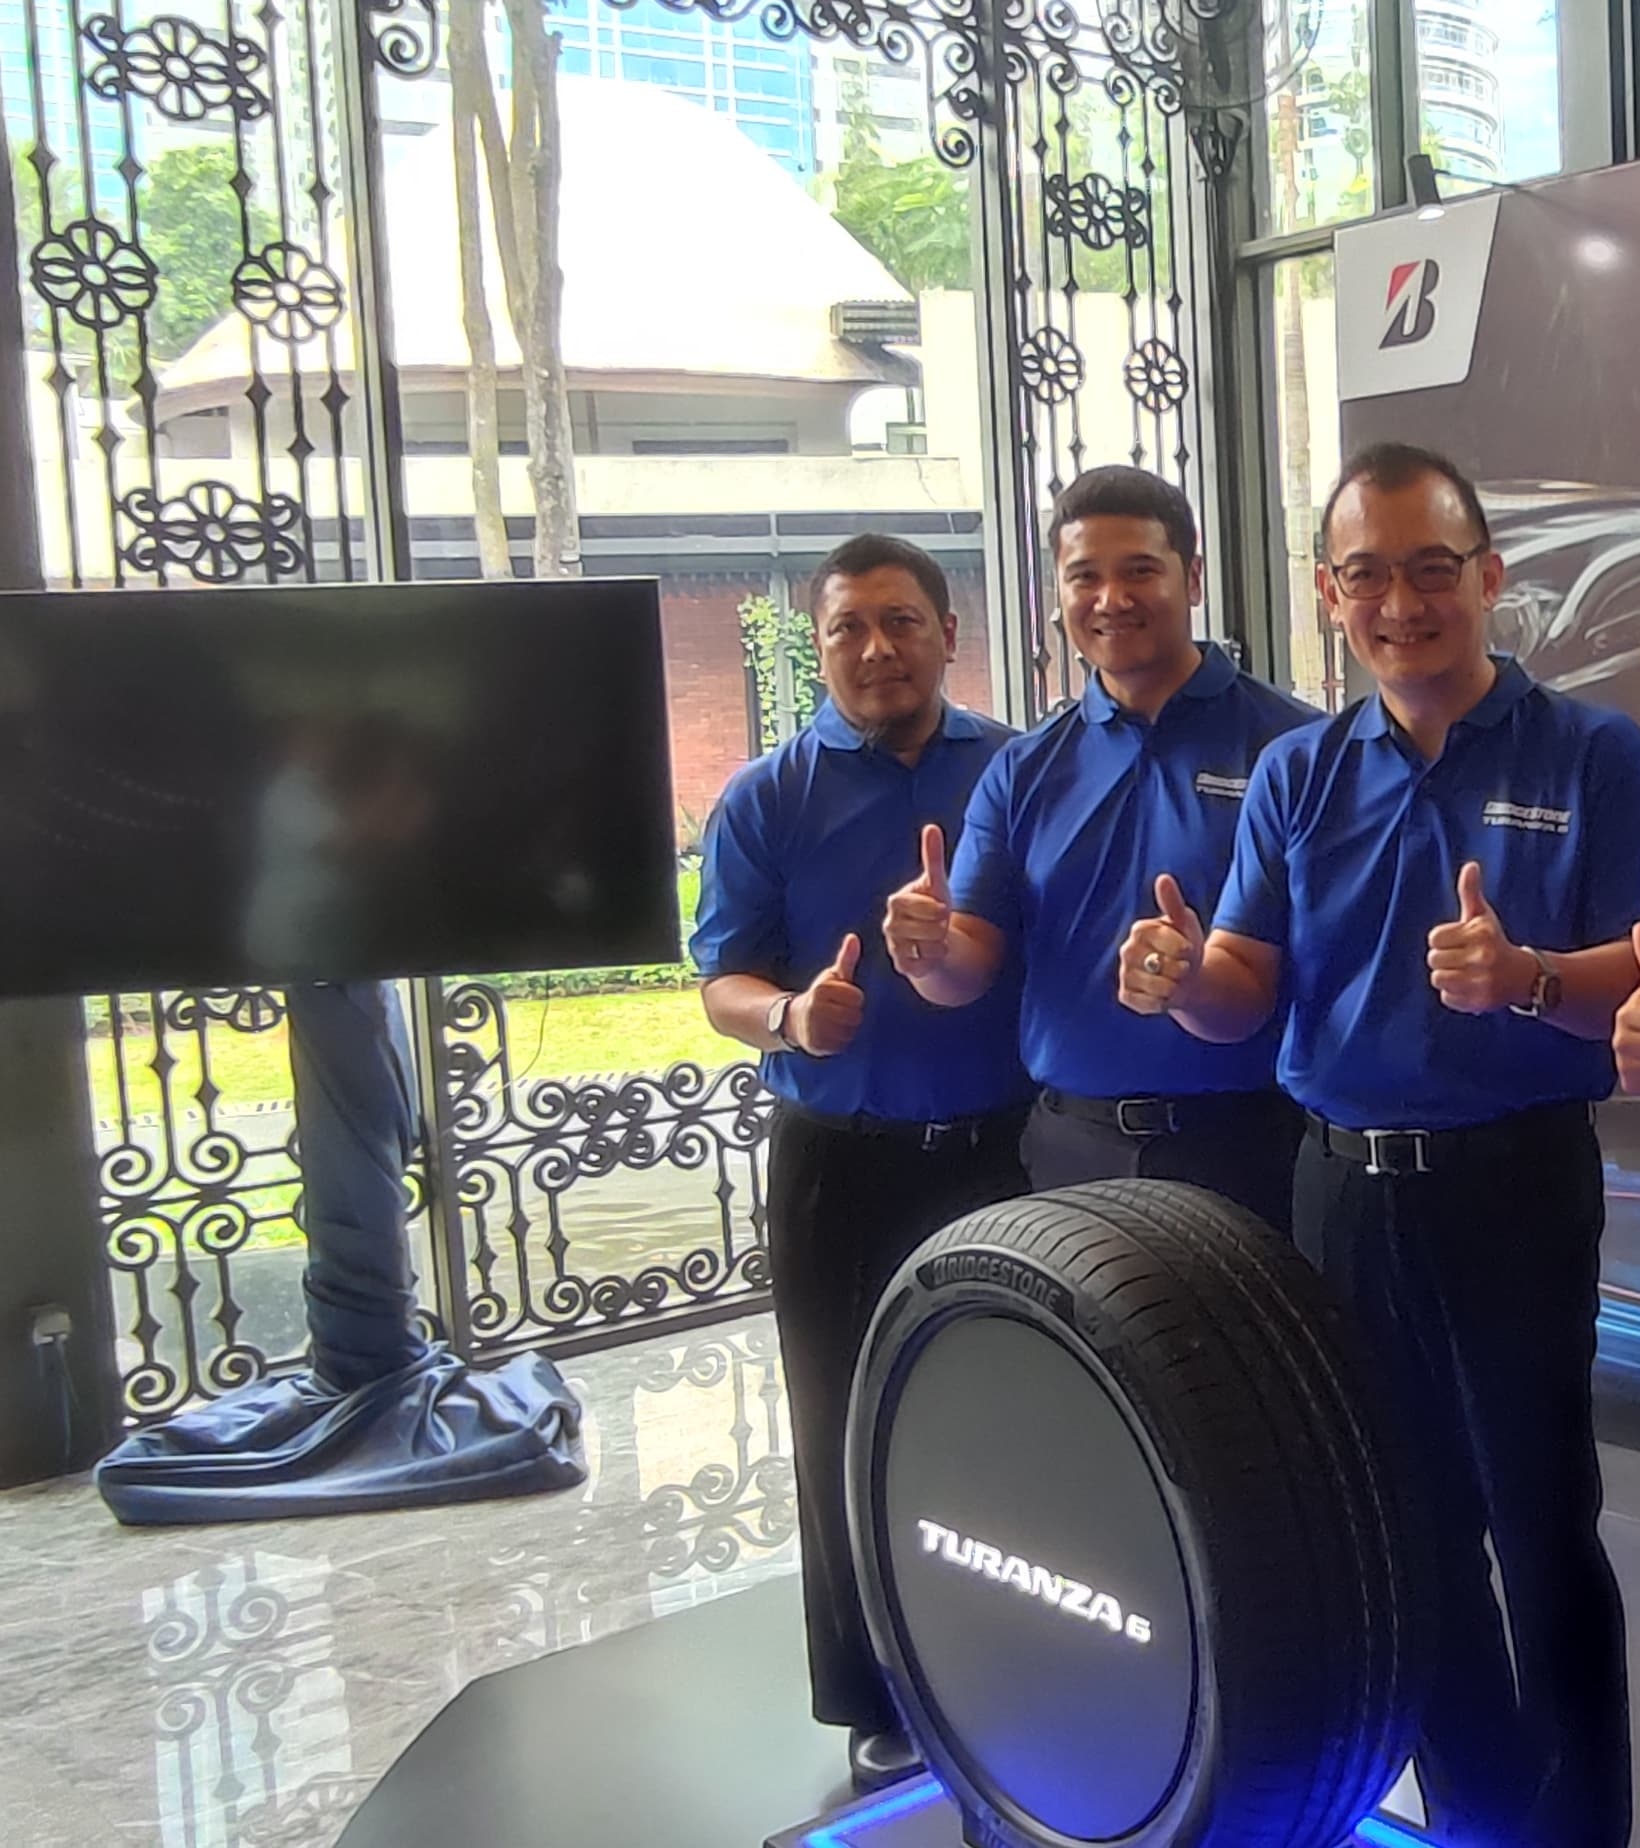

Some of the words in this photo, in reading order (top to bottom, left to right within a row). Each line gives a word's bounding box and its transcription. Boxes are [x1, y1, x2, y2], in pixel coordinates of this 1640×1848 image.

[932, 1255, 1062, 1311] BRIDGESTONE
[917, 1518, 1124, 1633] TURANZA
[1124, 1612, 1152, 1644] 6
